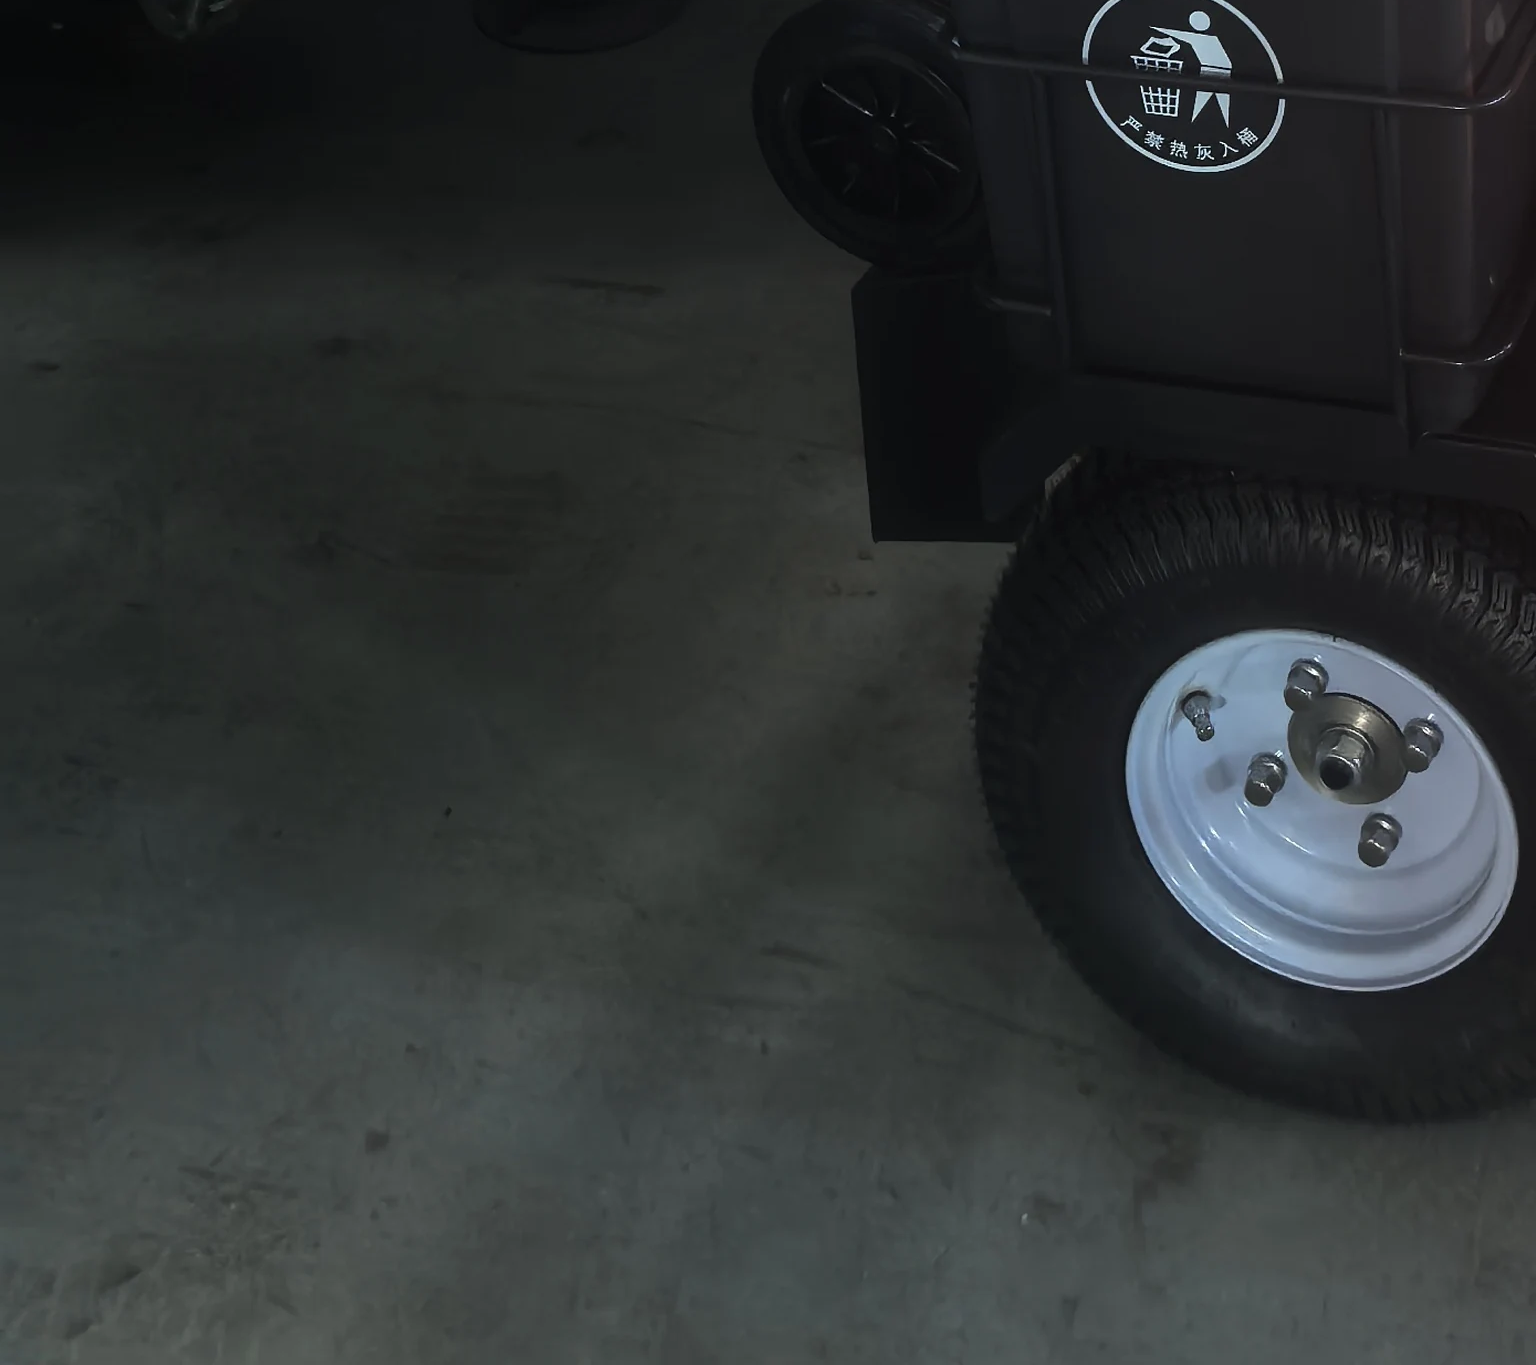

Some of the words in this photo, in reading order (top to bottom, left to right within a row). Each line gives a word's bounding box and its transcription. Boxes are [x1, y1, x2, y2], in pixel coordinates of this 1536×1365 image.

[1120, 115, 1259, 160] 严禁热灰入桶
